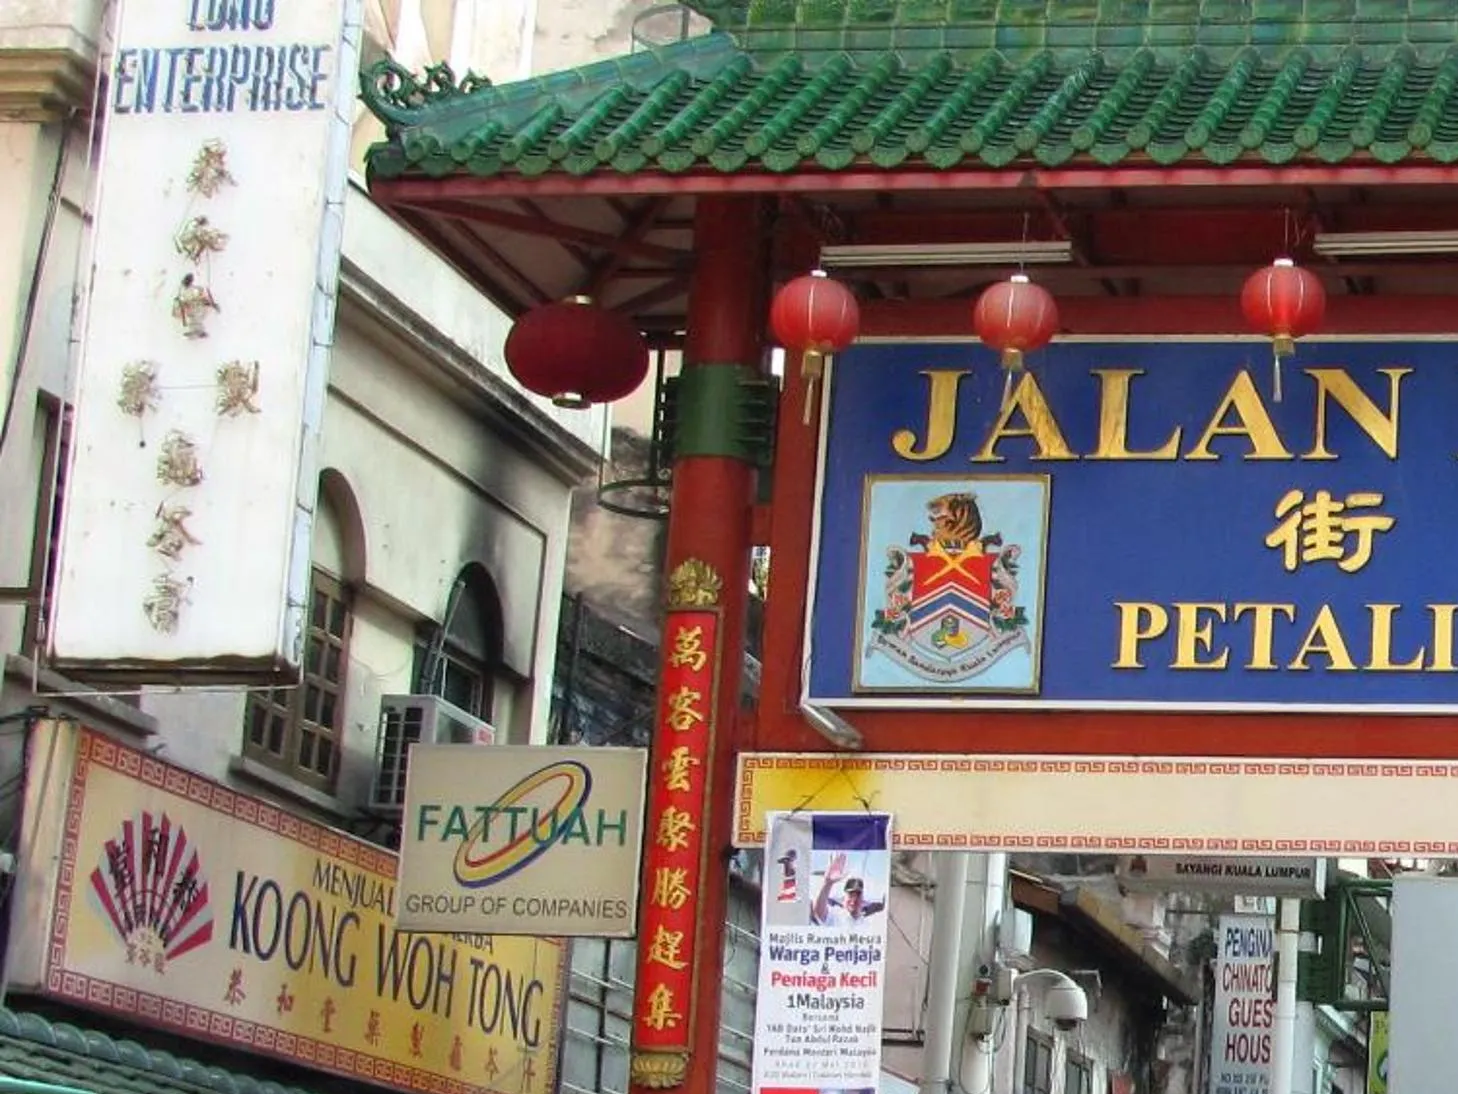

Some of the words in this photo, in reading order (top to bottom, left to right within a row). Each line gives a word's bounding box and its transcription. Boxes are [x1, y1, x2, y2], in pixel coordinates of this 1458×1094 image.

[114, 43, 332, 113] ENTERPRISE
[892, 367, 1414, 463] JALAN
[417, 804, 628, 847] FATTUAH
[1175, 862, 1222, 877] SAYANGI
[1225, 863, 1263, 878] KUALA
[1265, 864, 1312, 880] LUMPUR
[312, 857, 396, 918] MENJUAL
[405, 894, 477, 914] GROUP
[481, 897, 507, 915] OF
[512, 898, 629, 919] COMPANIES
[229, 869, 361, 988] KOONG
[377, 922, 459, 1020] WOH
[467, 955, 544, 1048] TONG
[769, 945, 820, 966] Warga
[824, 945, 882, 966] Penjaja
[771, 970, 837, 992] Peniaga
[839, 970, 878, 988] Kecil
[786, 993, 865, 1012] 1Malaysia
[1228, 997, 1274, 1029] GUES
[1224, 1032, 1272, 1064] HOUS
